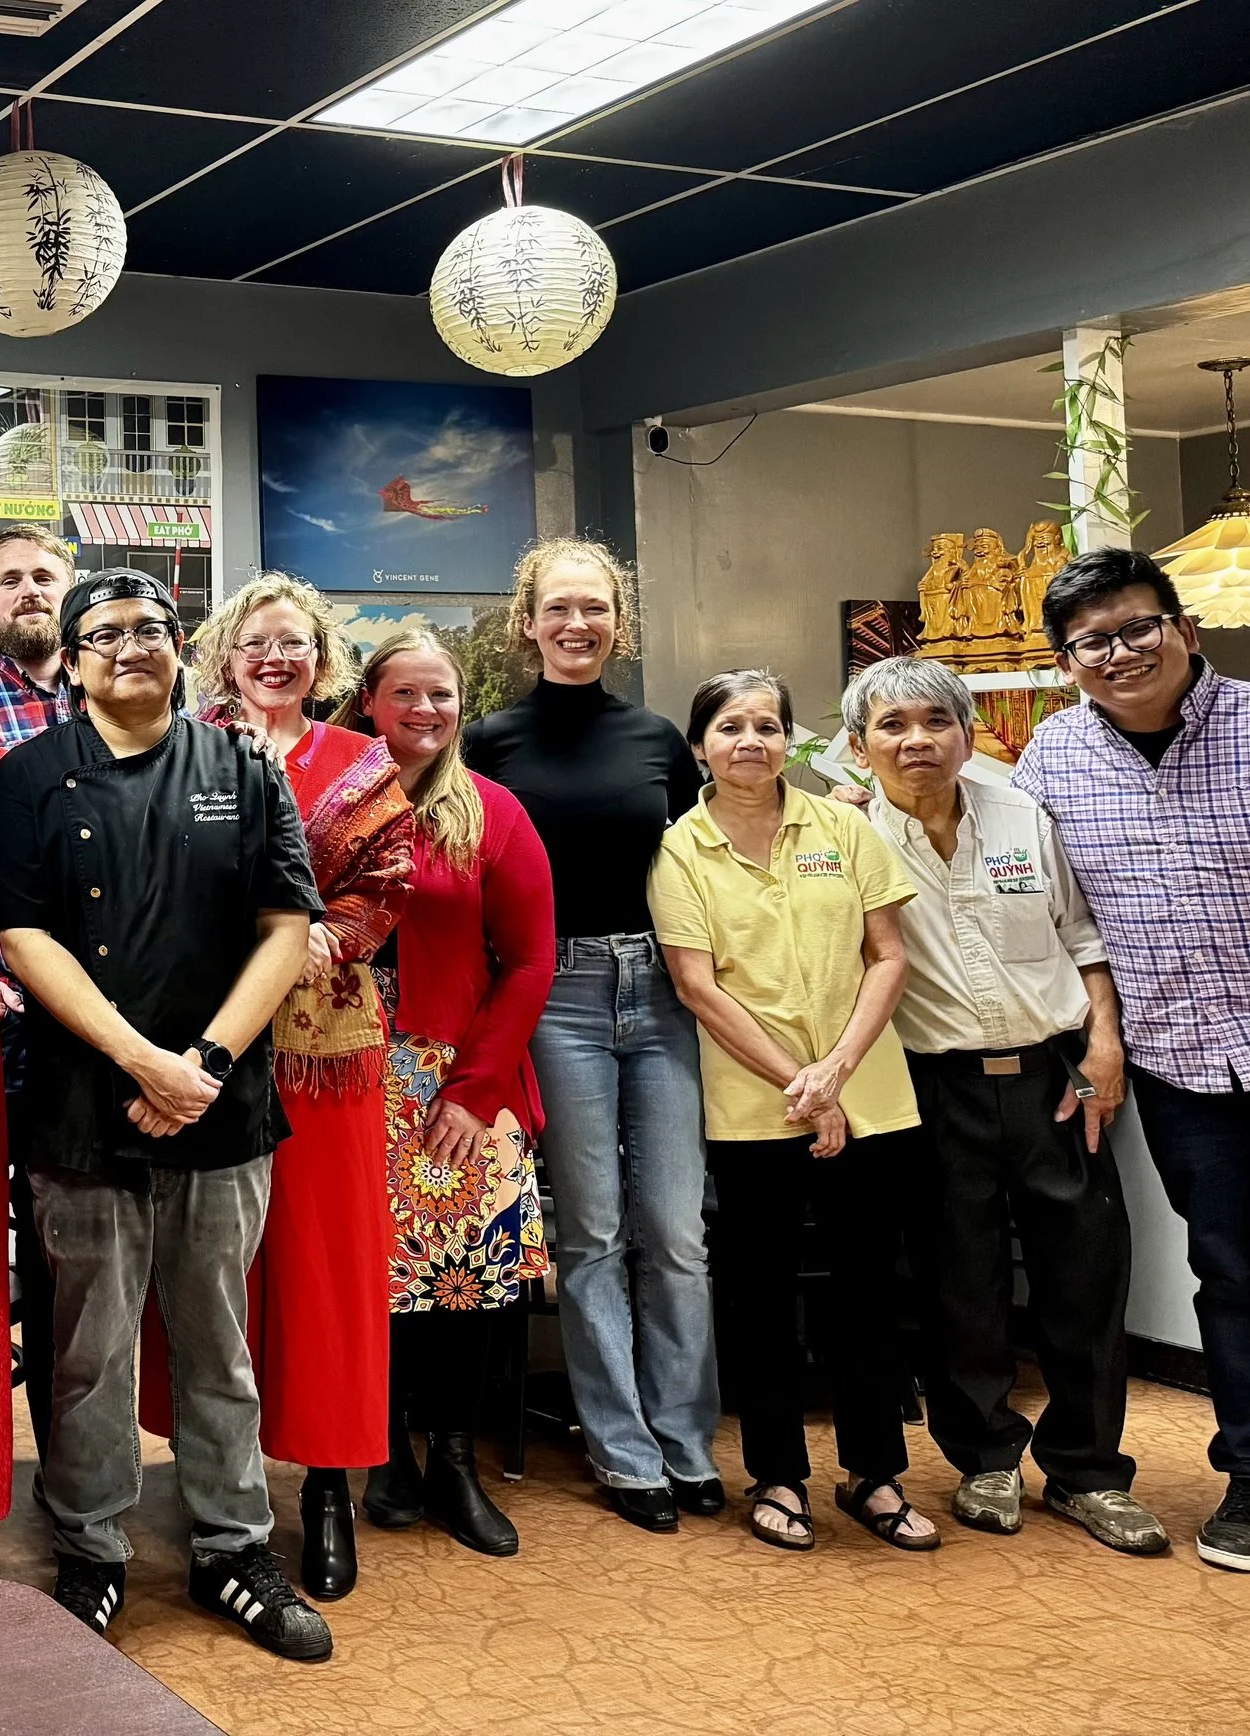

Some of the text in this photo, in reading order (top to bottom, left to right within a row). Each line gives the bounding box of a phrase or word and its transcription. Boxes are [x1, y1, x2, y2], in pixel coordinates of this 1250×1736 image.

[154, 525, 171, 535] EAT
[385, 574, 417, 582] VINCENT
[419, 574, 439, 582] GENE
[194, 813, 240, 823] Restaurant
